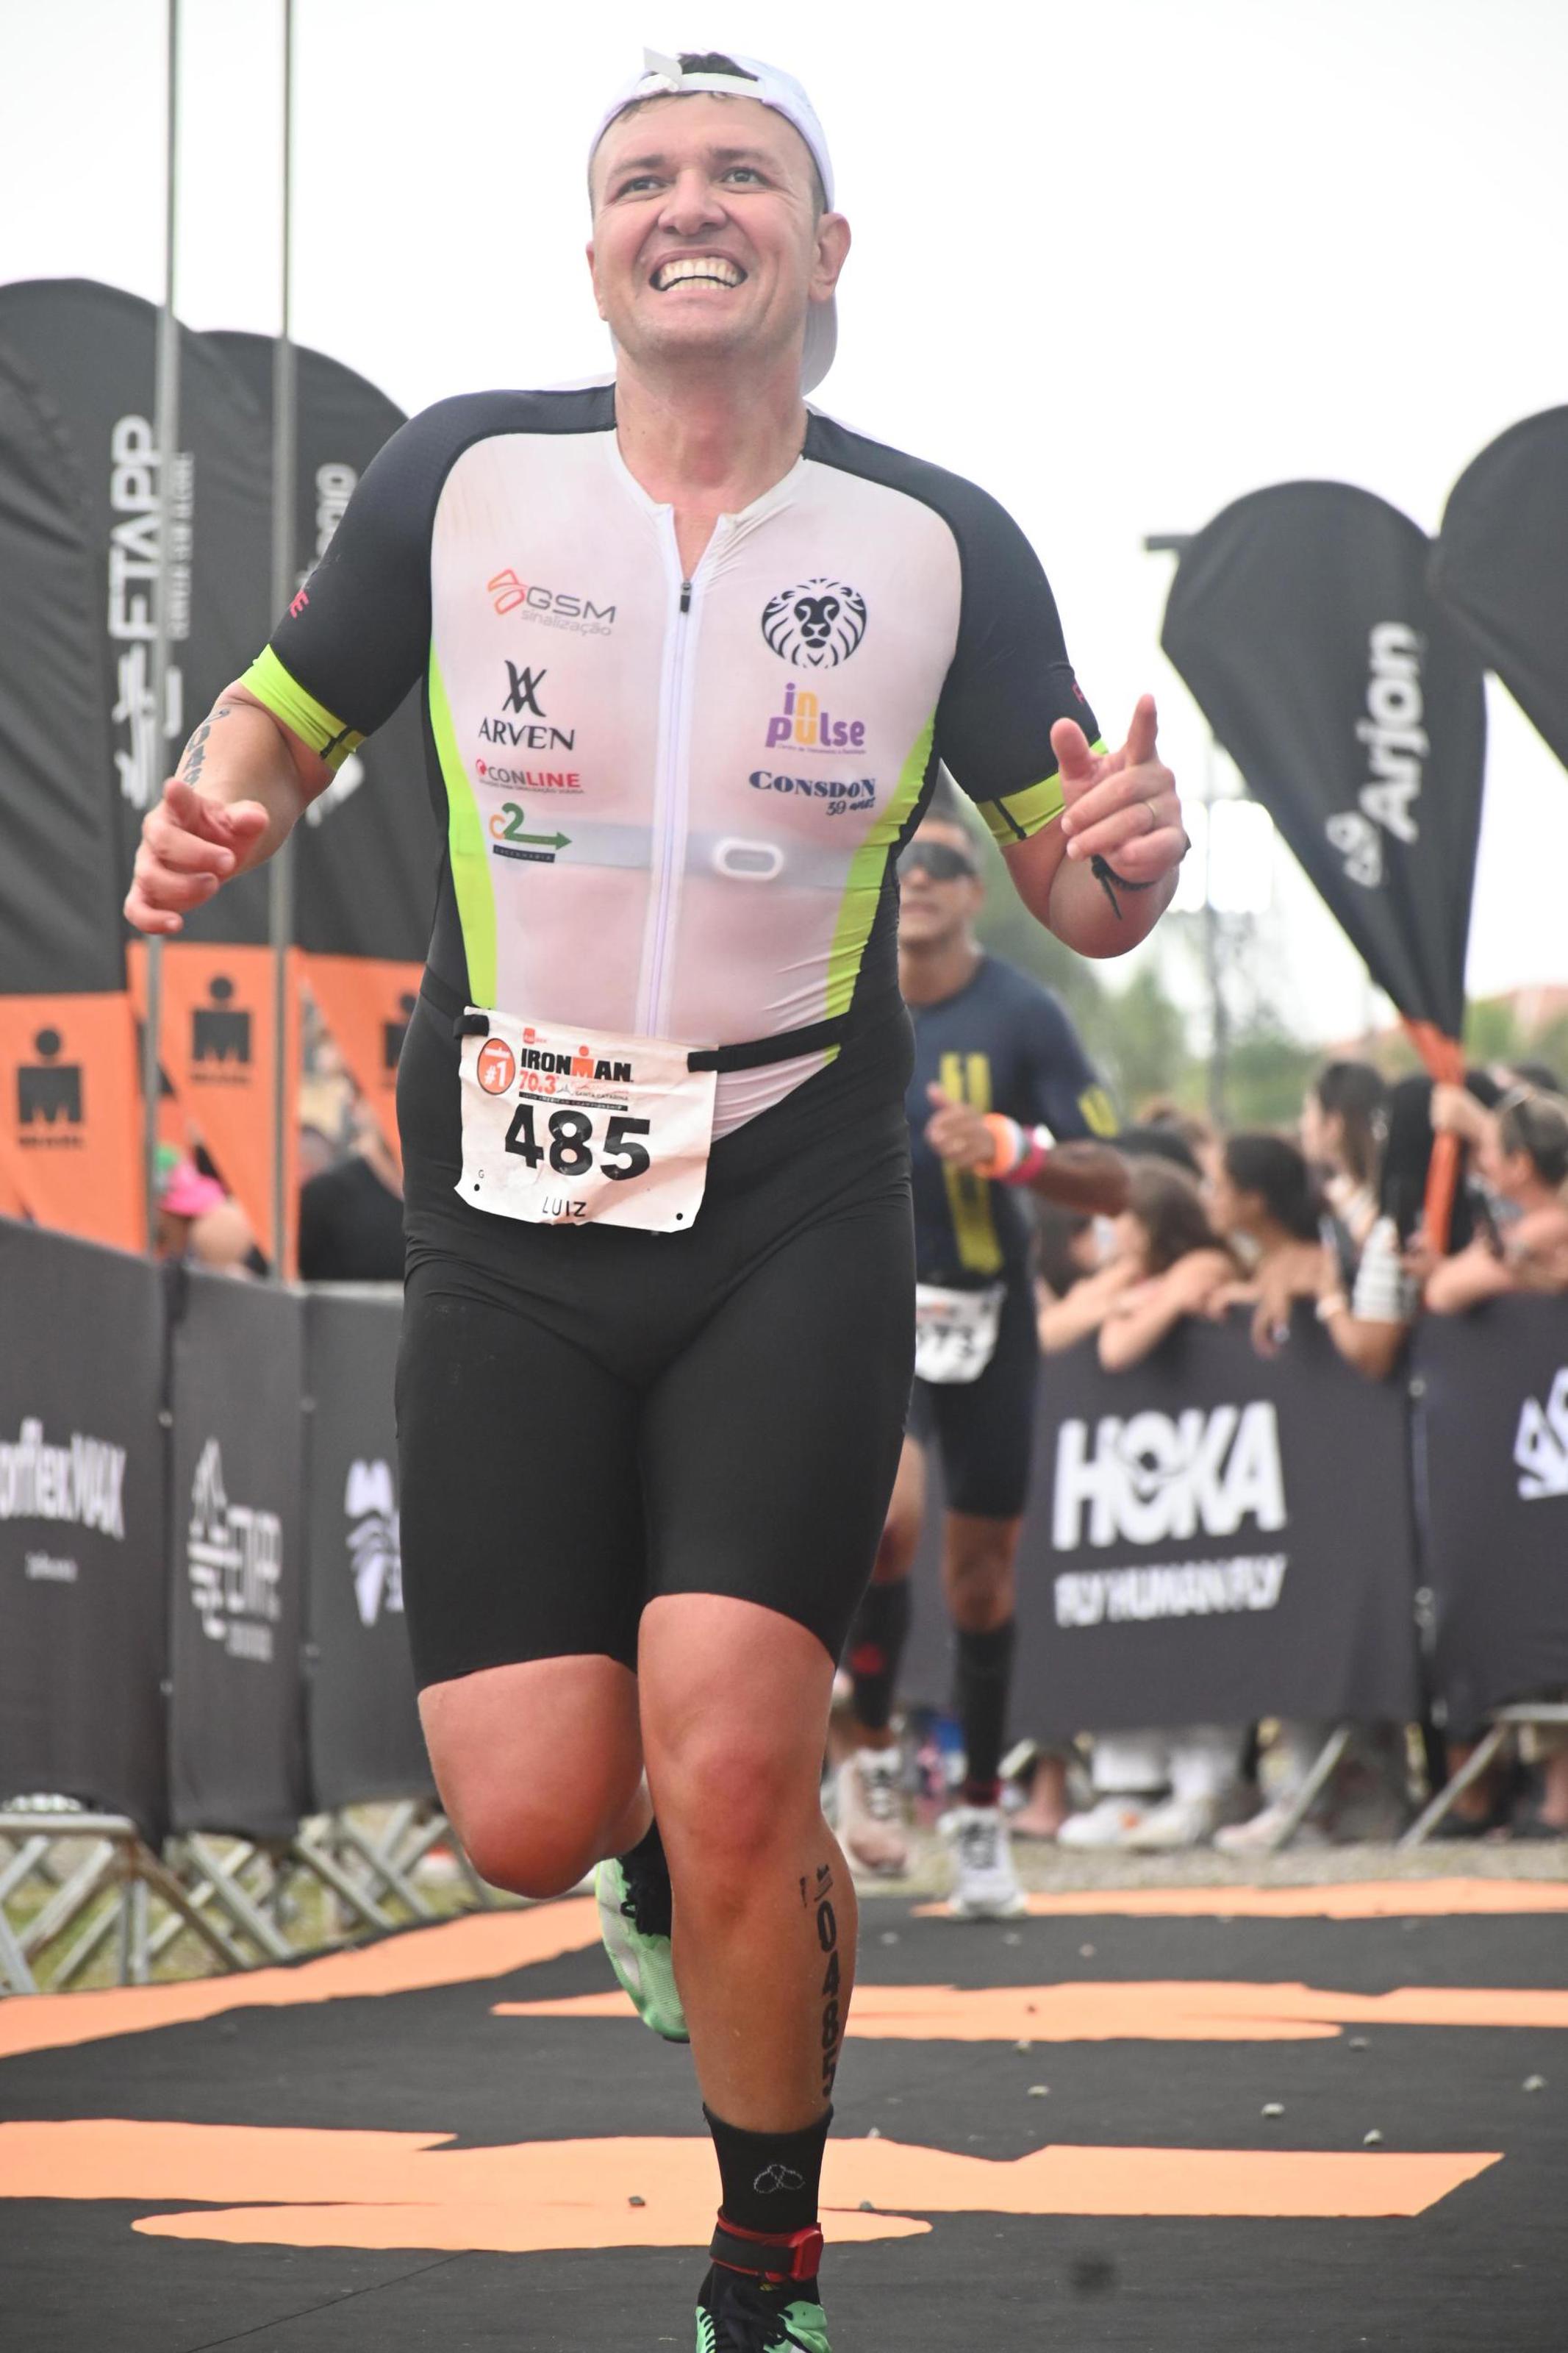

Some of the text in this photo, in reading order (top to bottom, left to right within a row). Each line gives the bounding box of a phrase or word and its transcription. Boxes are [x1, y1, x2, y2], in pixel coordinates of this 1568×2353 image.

[526, 586, 617, 623] GSM
[520, 610, 612, 637] sinalização
[478, 717, 576, 751] ARVEN
[488, 766, 581, 788] CONLINE
[484, 1060, 508, 1088] #1
[520, 1045, 634, 1083] IRONMAN
[518, 1070, 558, 1095] 70.3
[504, 1103, 651, 1181] 485
[543, 1196, 587, 1218] LUIZ
[1052, 1400, 1287, 1552] HOKA
